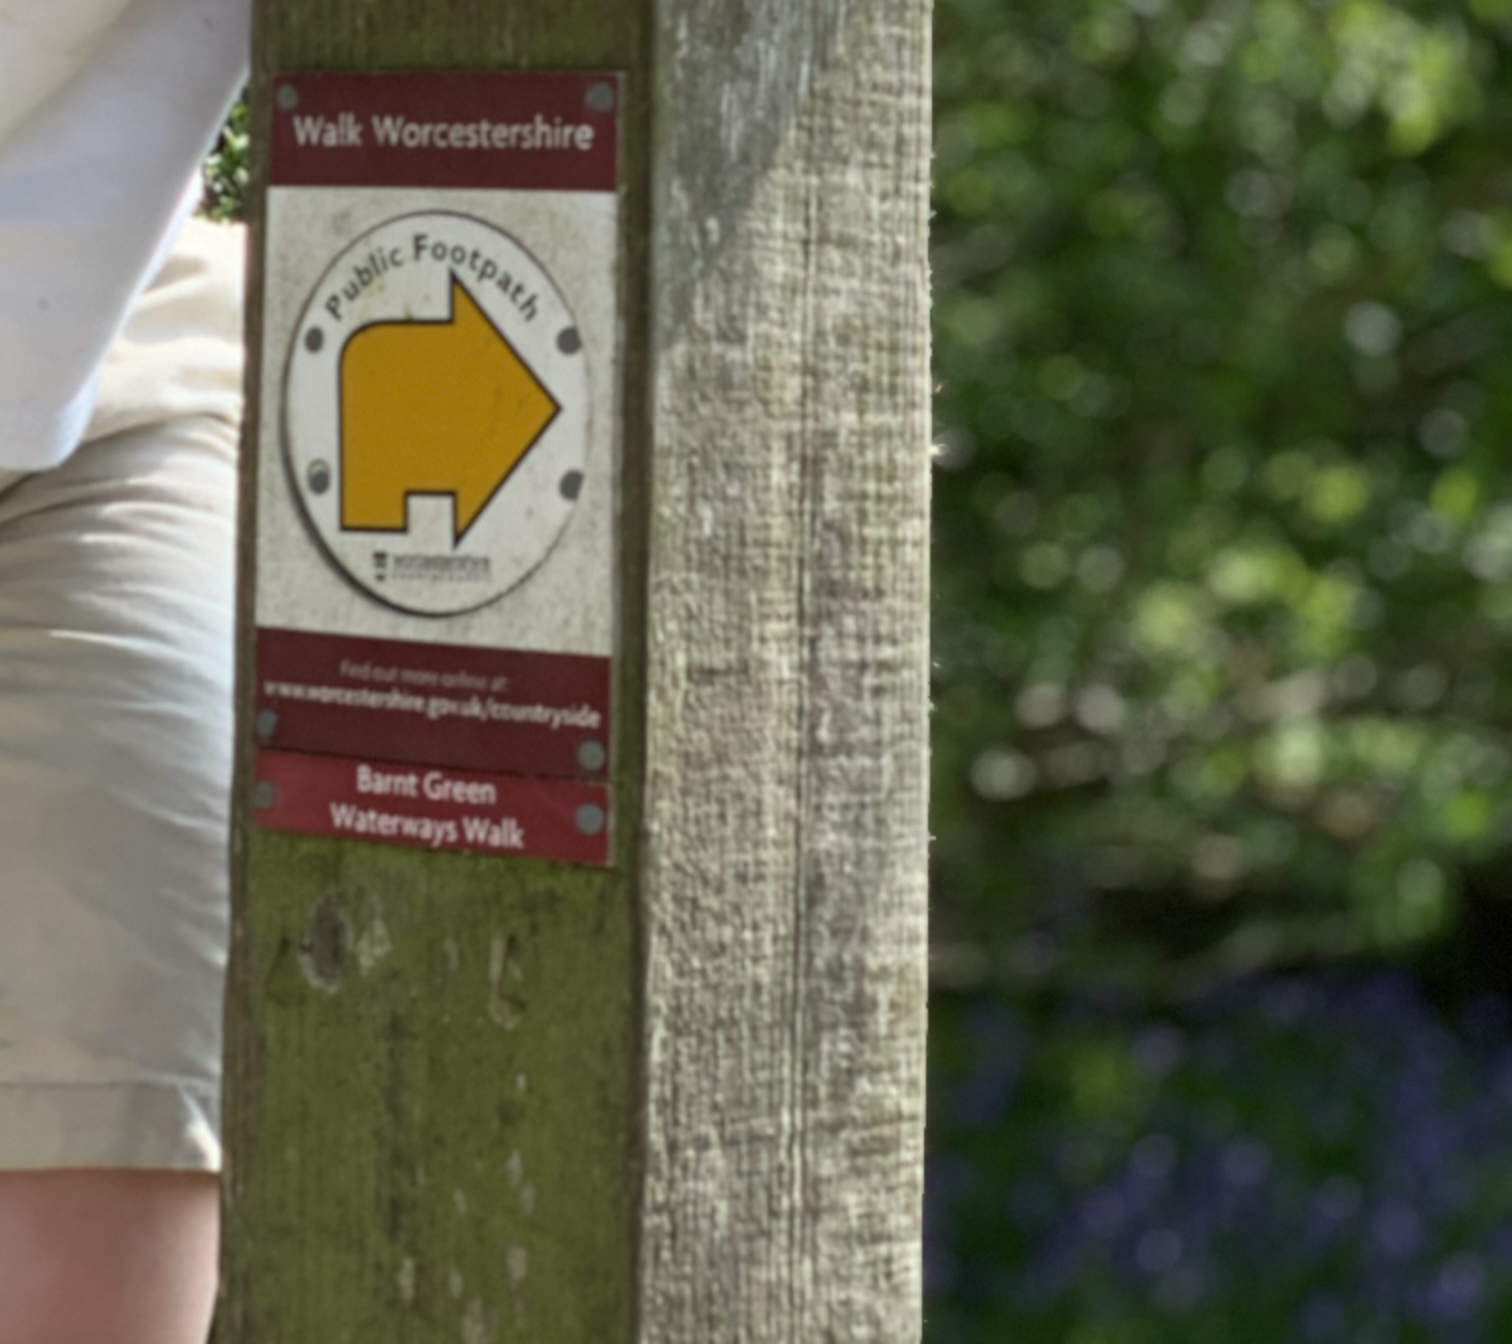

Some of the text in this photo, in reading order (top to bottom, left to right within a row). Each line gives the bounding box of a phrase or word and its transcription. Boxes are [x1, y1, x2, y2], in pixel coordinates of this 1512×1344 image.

[293, 112, 595, 151] Walk Worcestershire
[324, 233, 540, 323] Public Footpath
[356, 763, 496, 805] Barnt Green
[330, 801, 524, 849] Waterways Walk
